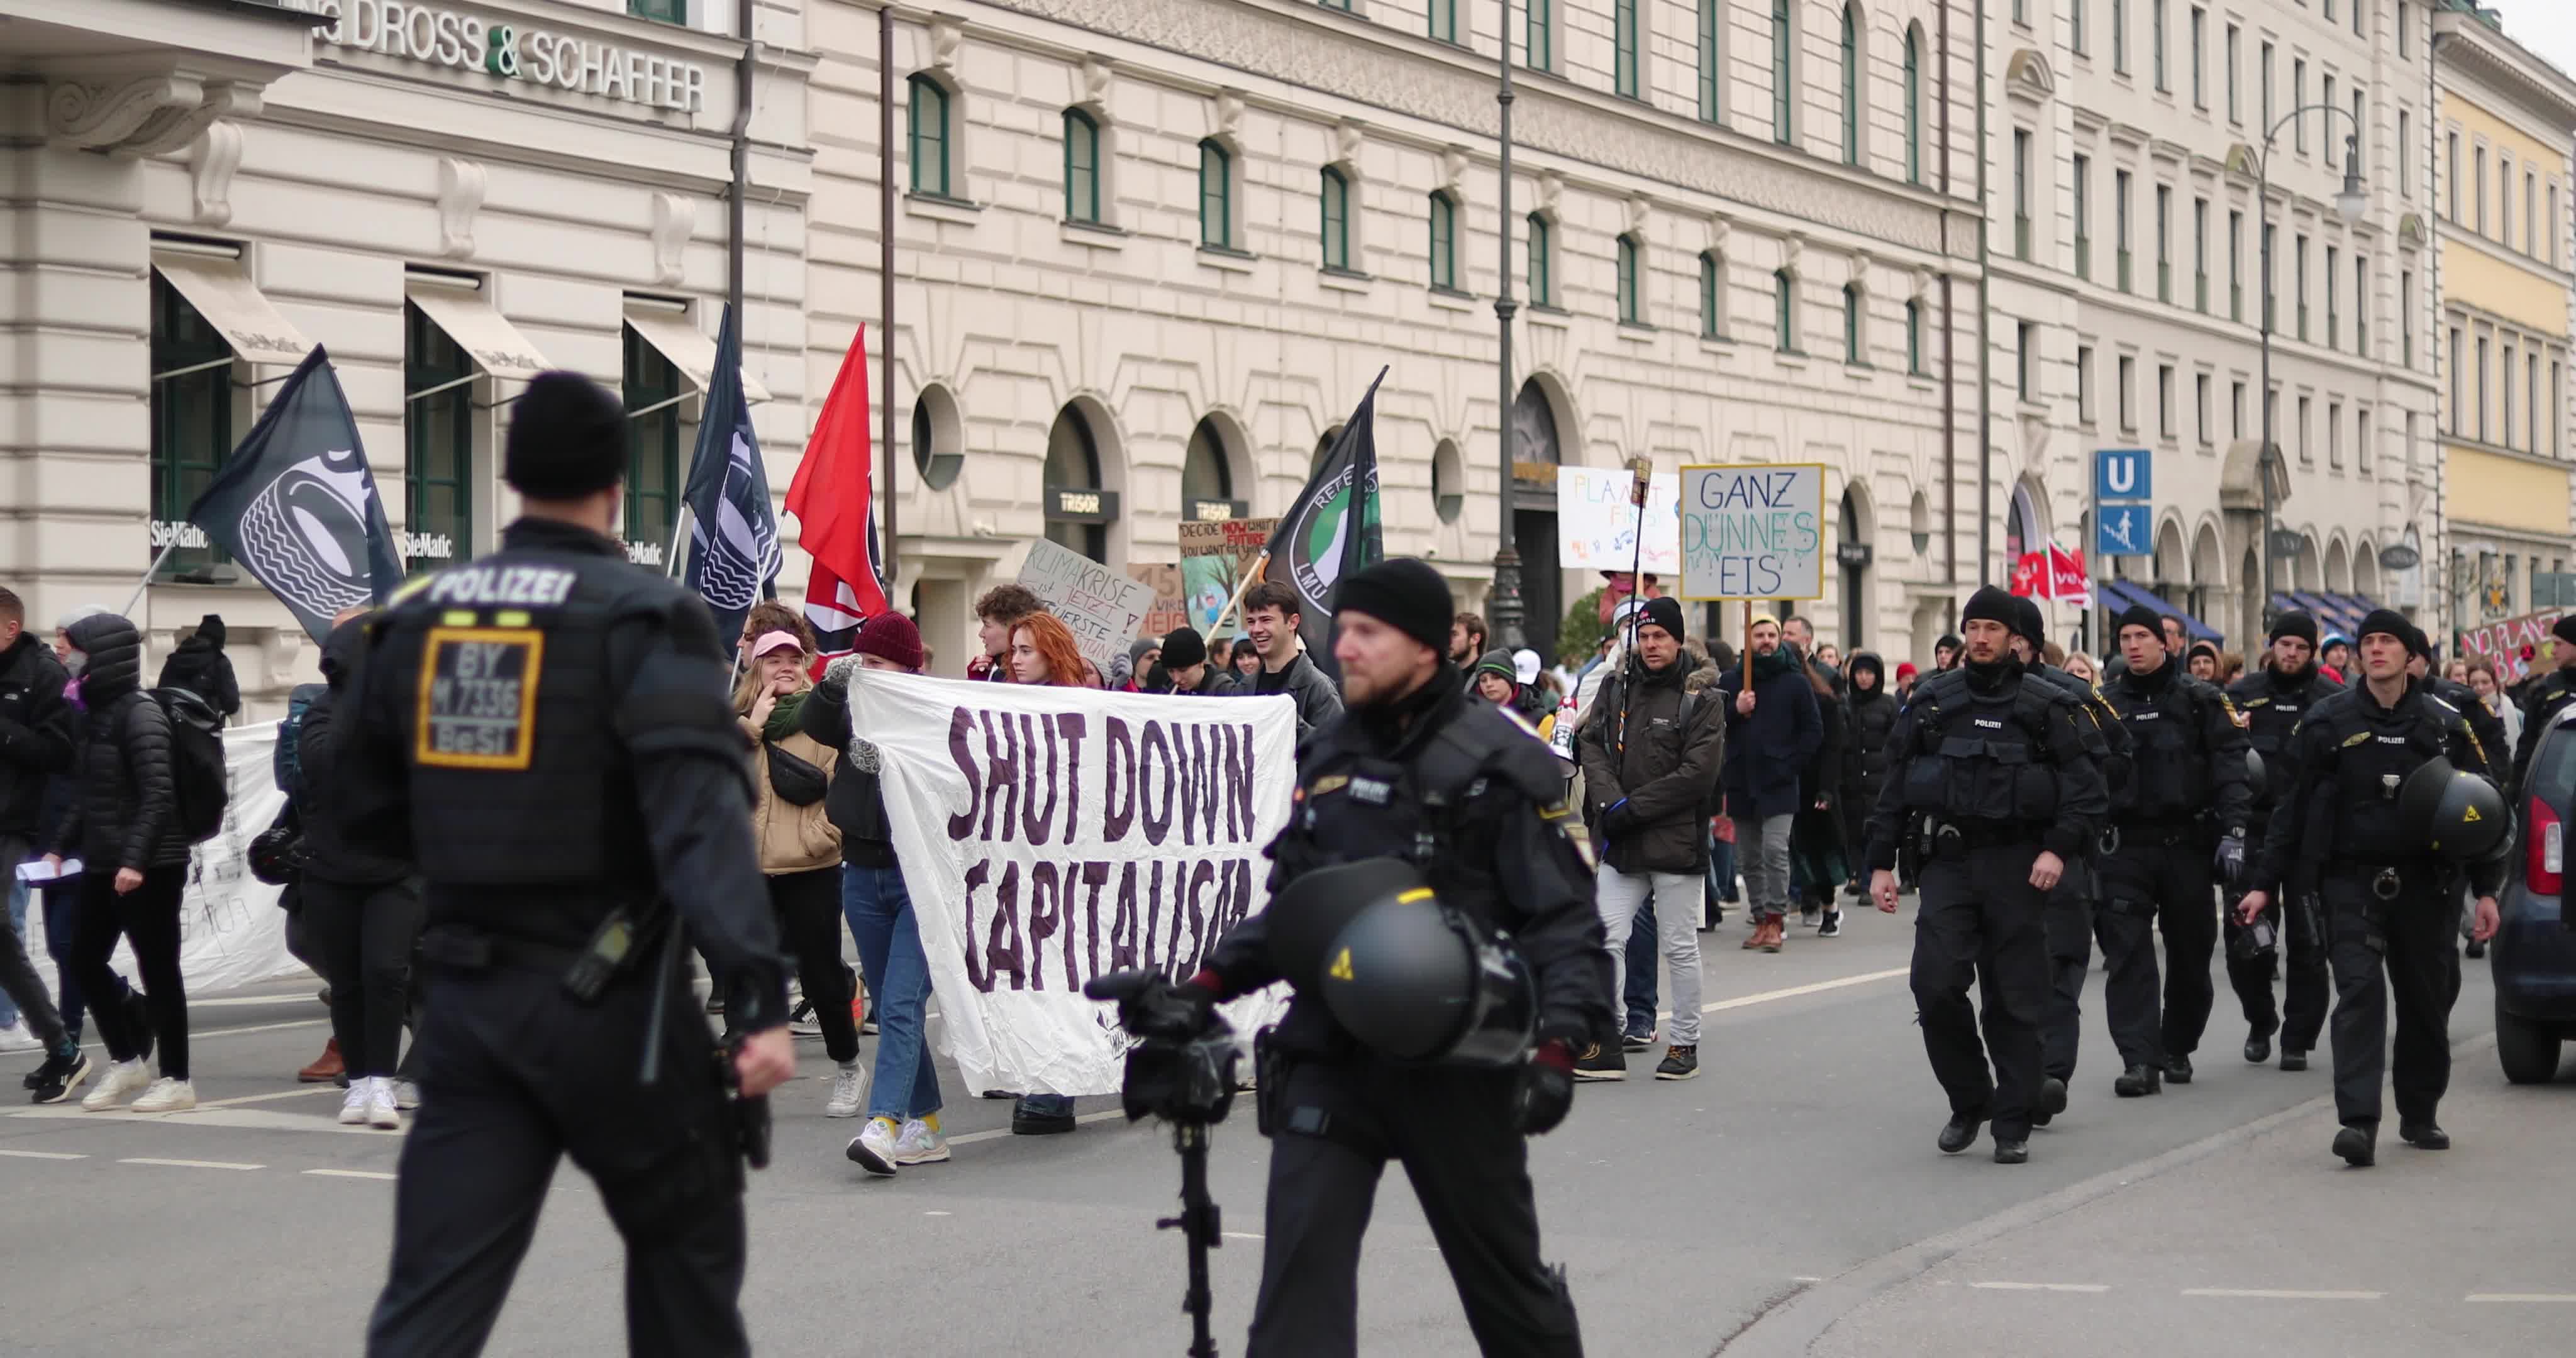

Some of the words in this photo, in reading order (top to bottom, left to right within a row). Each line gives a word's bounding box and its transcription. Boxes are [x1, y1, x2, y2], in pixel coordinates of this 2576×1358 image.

[353, 0, 484, 72] DROSS
[519, 30, 705, 113] SCHAFFER
[1574, 474, 1662, 506] PLANT
[1700, 472, 1797, 509] GANZ
[2108, 457, 2135, 493] U
[428, 568, 576, 604] POLIZEI
[1025, 544, 1138, 610] KLIMAKRISE
[1296, 562, 1328, 601] LMU
[1721, 555, 1782, 595] EIS
[1057, 585, 1118, 619] JETZT
[457, 643, 508, 679] BY
[1974, 719, 2002, 729] POLIZEI
[2136, 712, 2159, 721] POLIZEI
[2377, 736, 2405, 744] POLIZEI
[947, 705, 1085, 846] SHUT
[1104, 715, 1256, 847] DOWN
